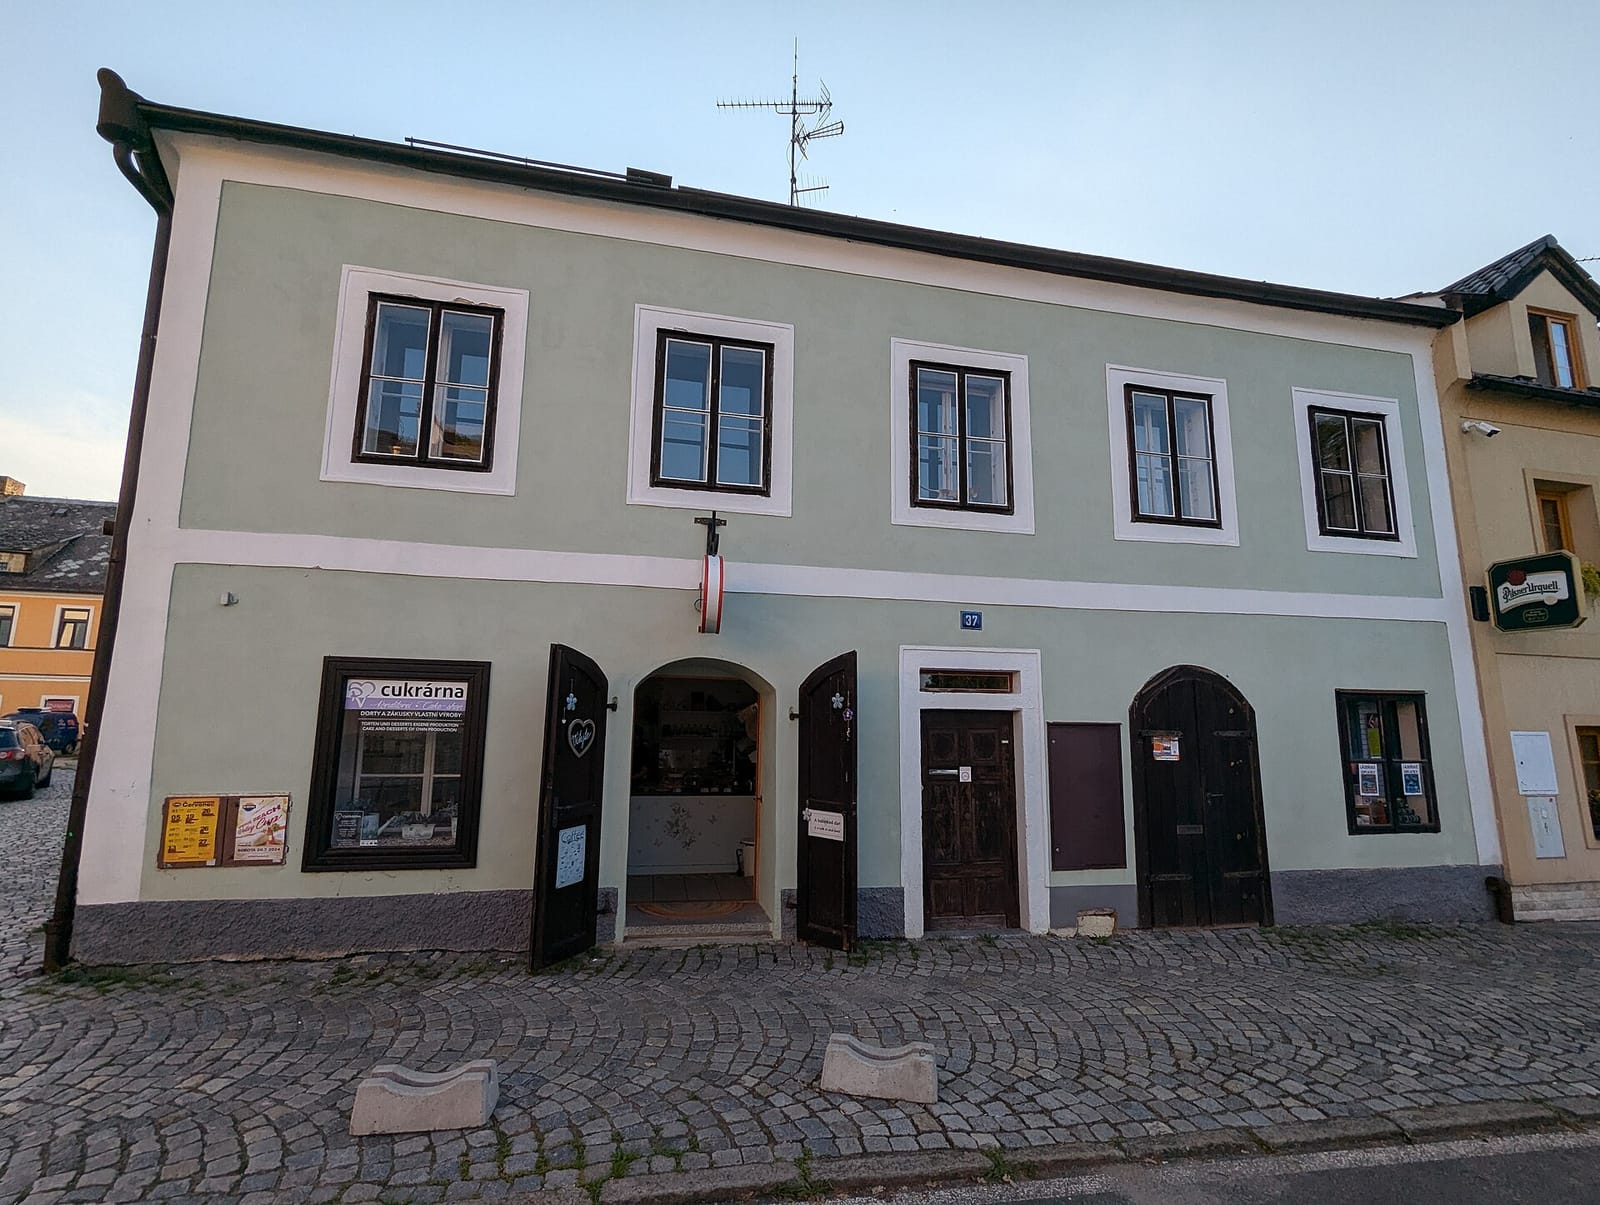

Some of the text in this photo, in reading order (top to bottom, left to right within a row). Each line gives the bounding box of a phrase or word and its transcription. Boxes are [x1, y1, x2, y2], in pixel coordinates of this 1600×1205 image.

[1502, 581, 1558, 603] Pilsner Urquell
[965, 615, 978, 627] 37
[381, 682, 464, 699] cukrárna
